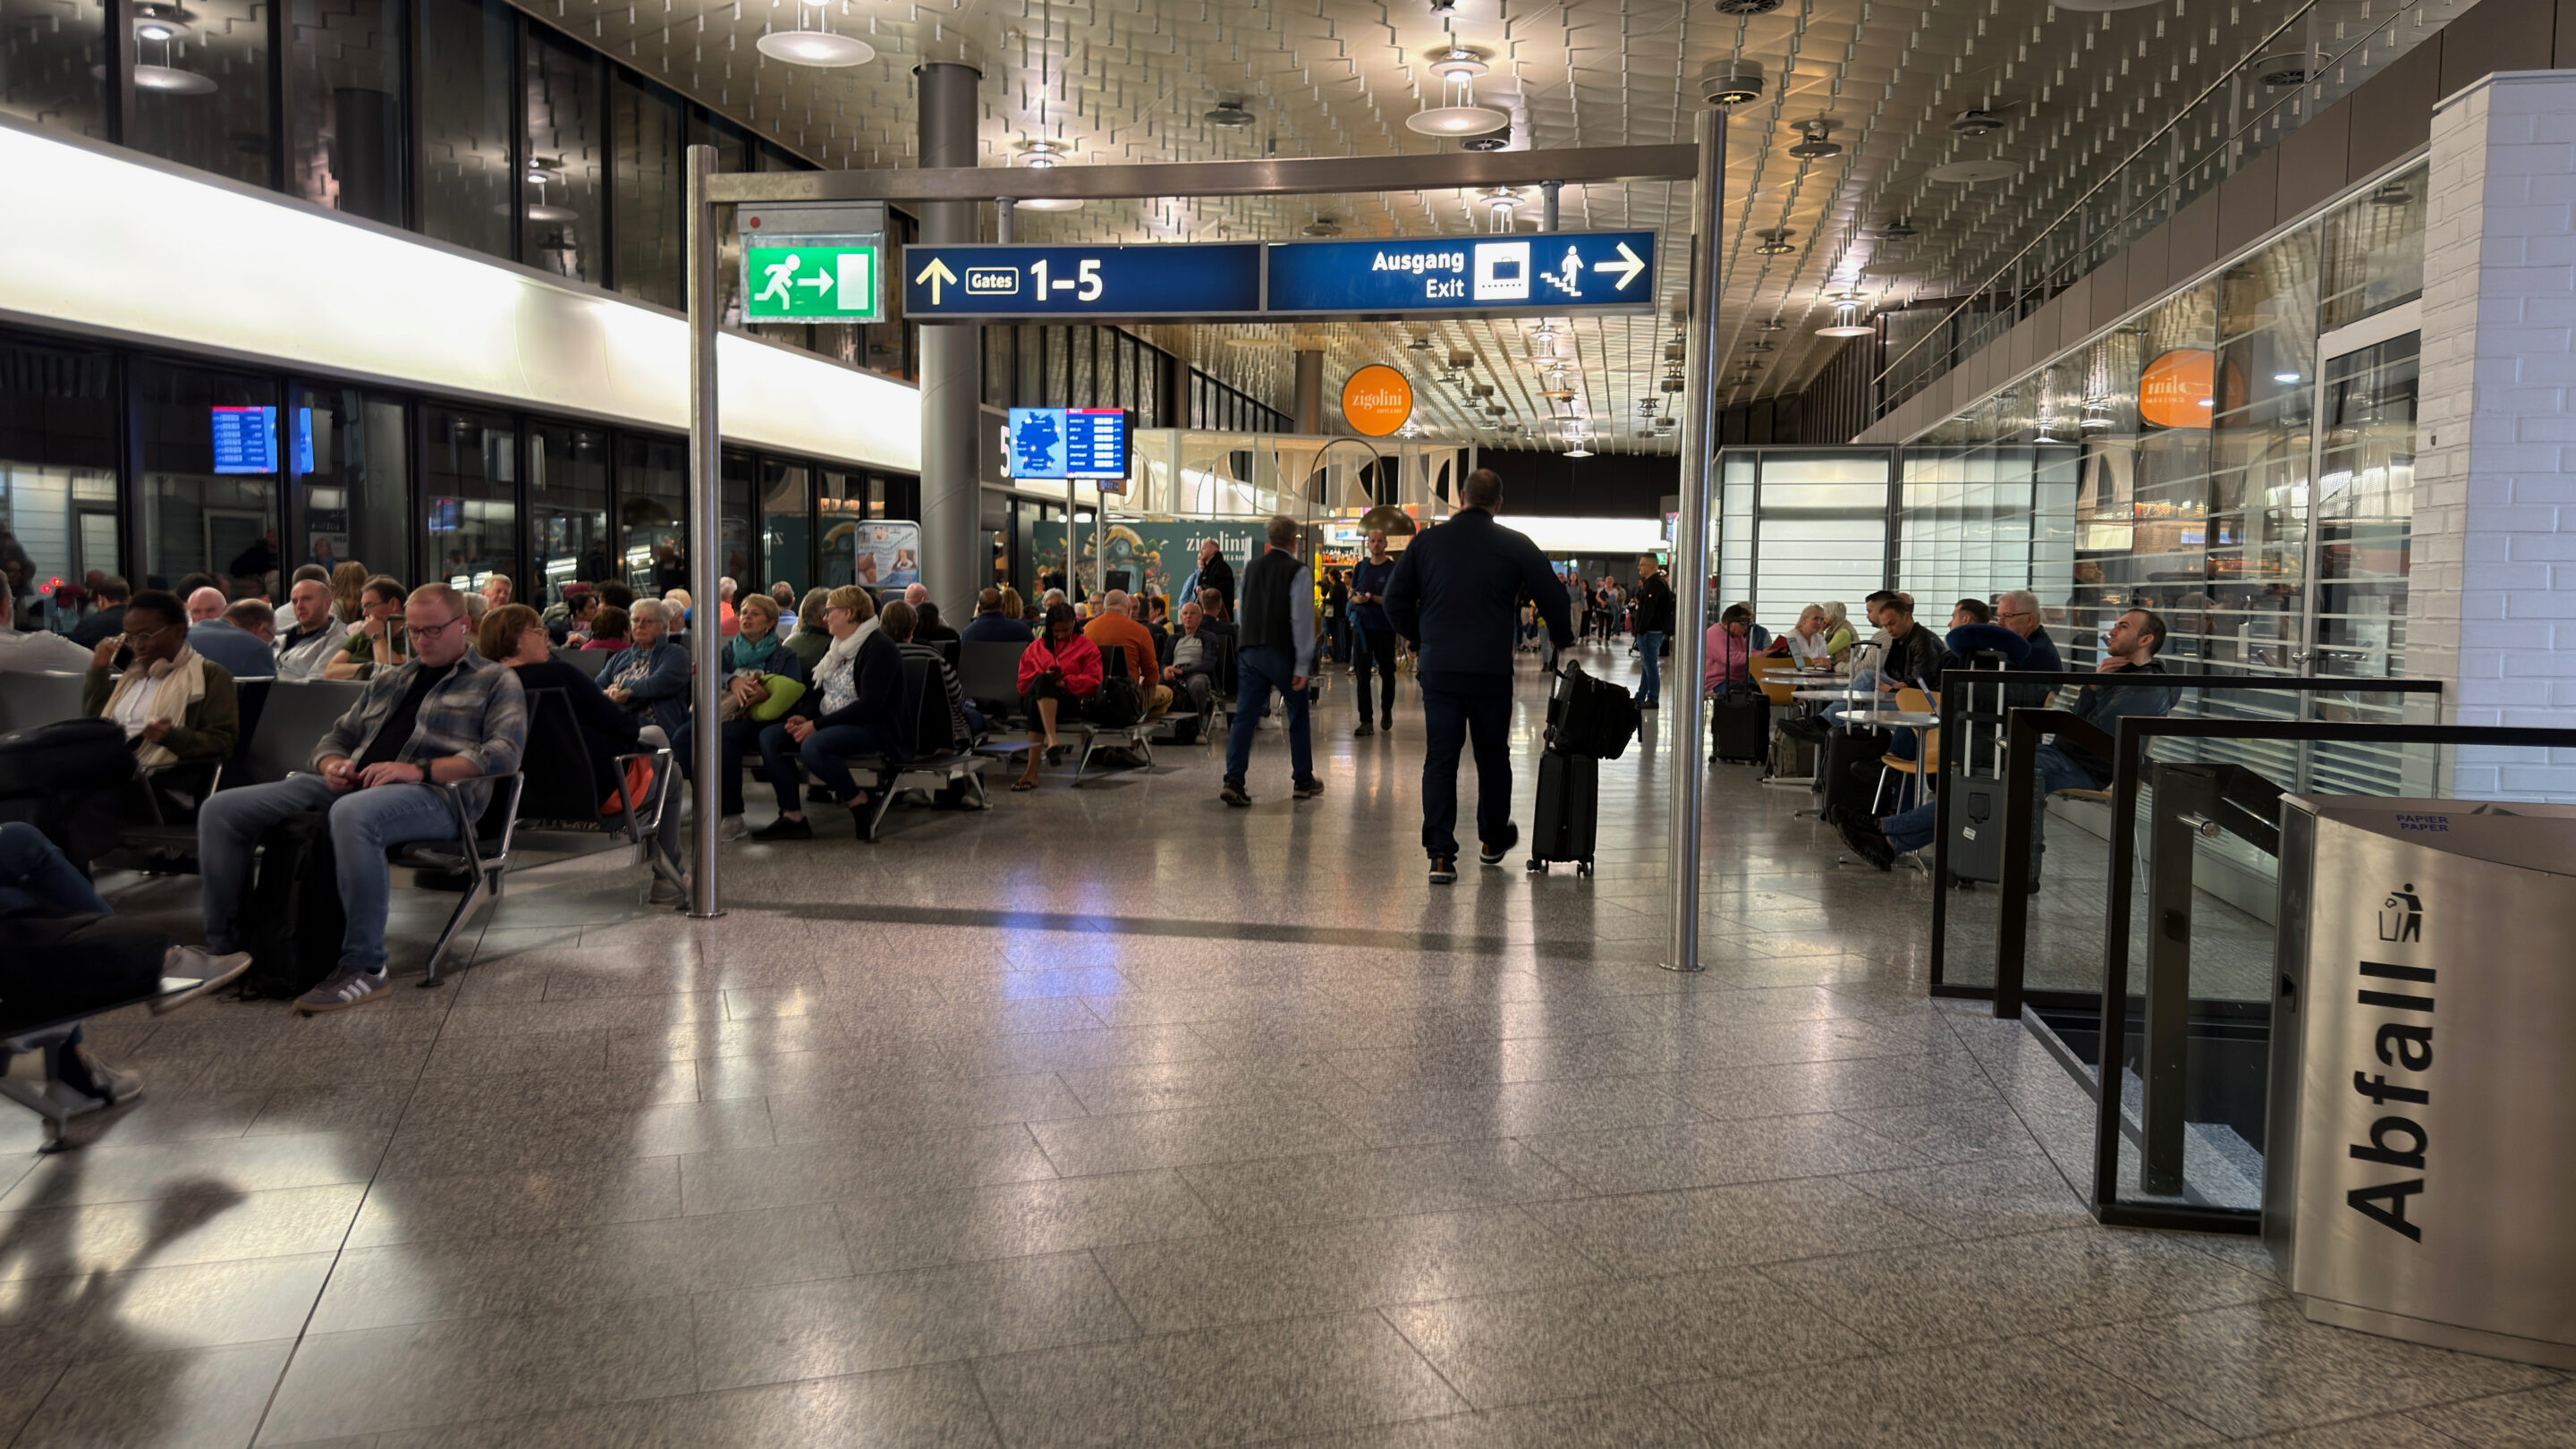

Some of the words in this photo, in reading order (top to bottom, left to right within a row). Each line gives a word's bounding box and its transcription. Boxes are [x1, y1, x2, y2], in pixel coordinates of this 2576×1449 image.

[1371, 250, 1465, 275] Ausgang
[971, 273, 1013, 289] Gates
[1426, 277, 1465, 299] Exit
[1352, 387, 1402, 411] zigolini
[1000, 425, 1011, 478] 5
[1186, 530, 1246, 552] zilini
[2396, 815, 2448, 824] PAPIER
[2401, 823, 2449, 832] PAPER
[2347, 961, 2436, 1243] Abfall
